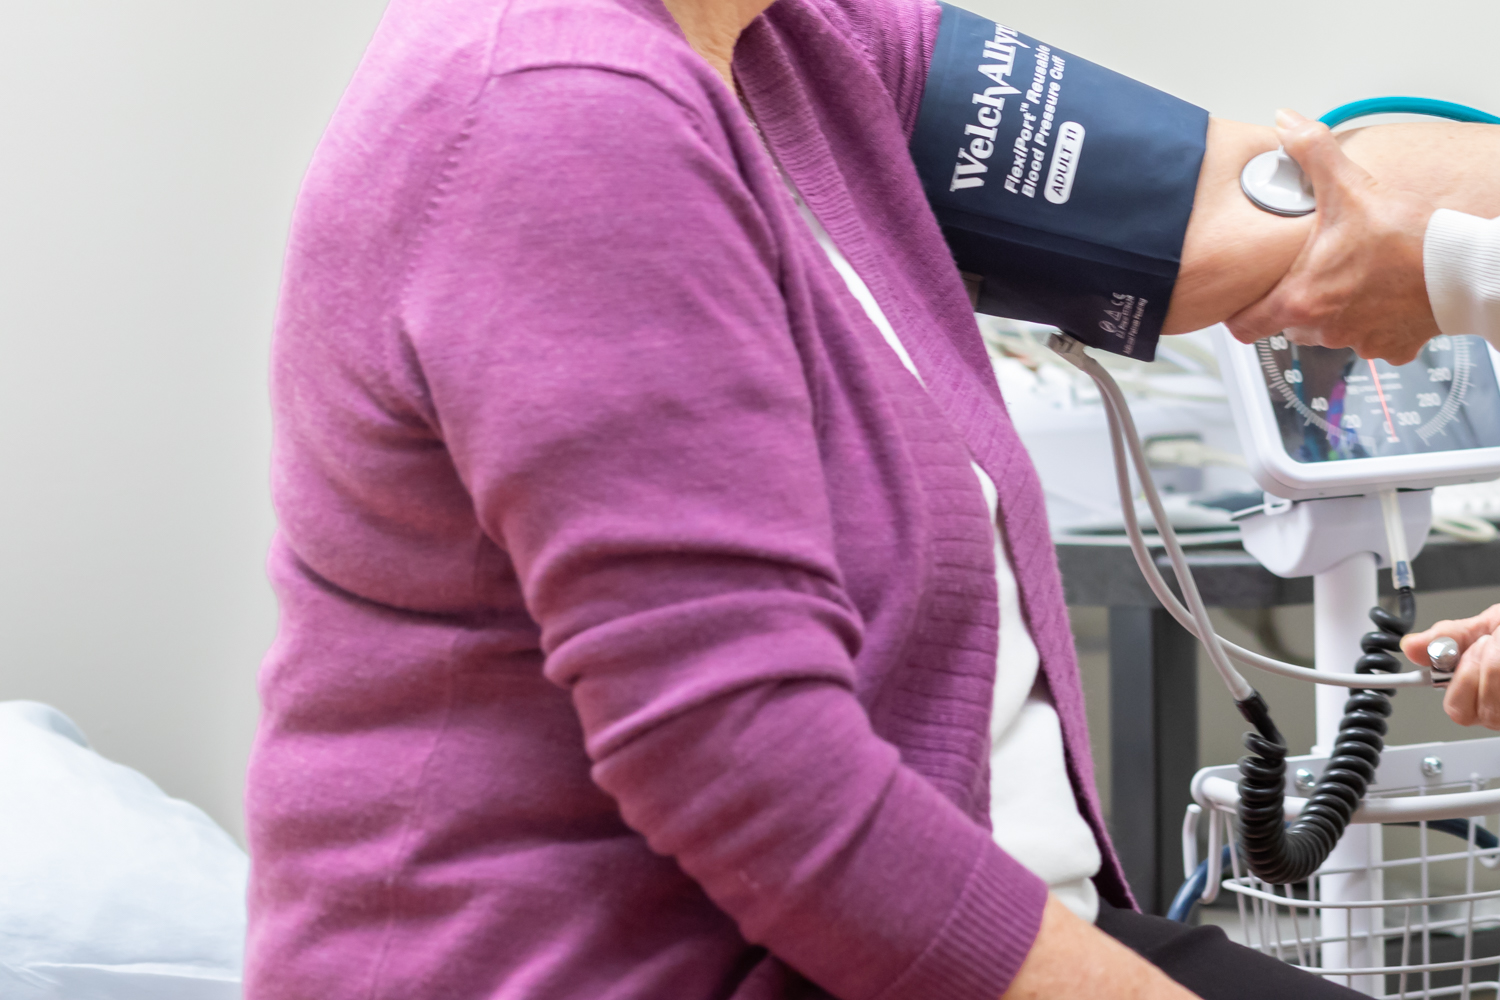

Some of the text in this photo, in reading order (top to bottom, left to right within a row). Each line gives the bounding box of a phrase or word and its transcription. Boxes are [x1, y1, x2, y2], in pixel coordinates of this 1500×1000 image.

[1026, 44, 1051, 105] Reusable
[1021, 55, 1066, 198] Blood Pressure Cuff
[1051, 128, 1079, 197] ADULT 11
[1269, 335, 1288, 351] 80
[1283, 369, 1303, 384] 60
[1310, 396, 1329, 412] 40
[1396, 411, 1421, 427] 300
